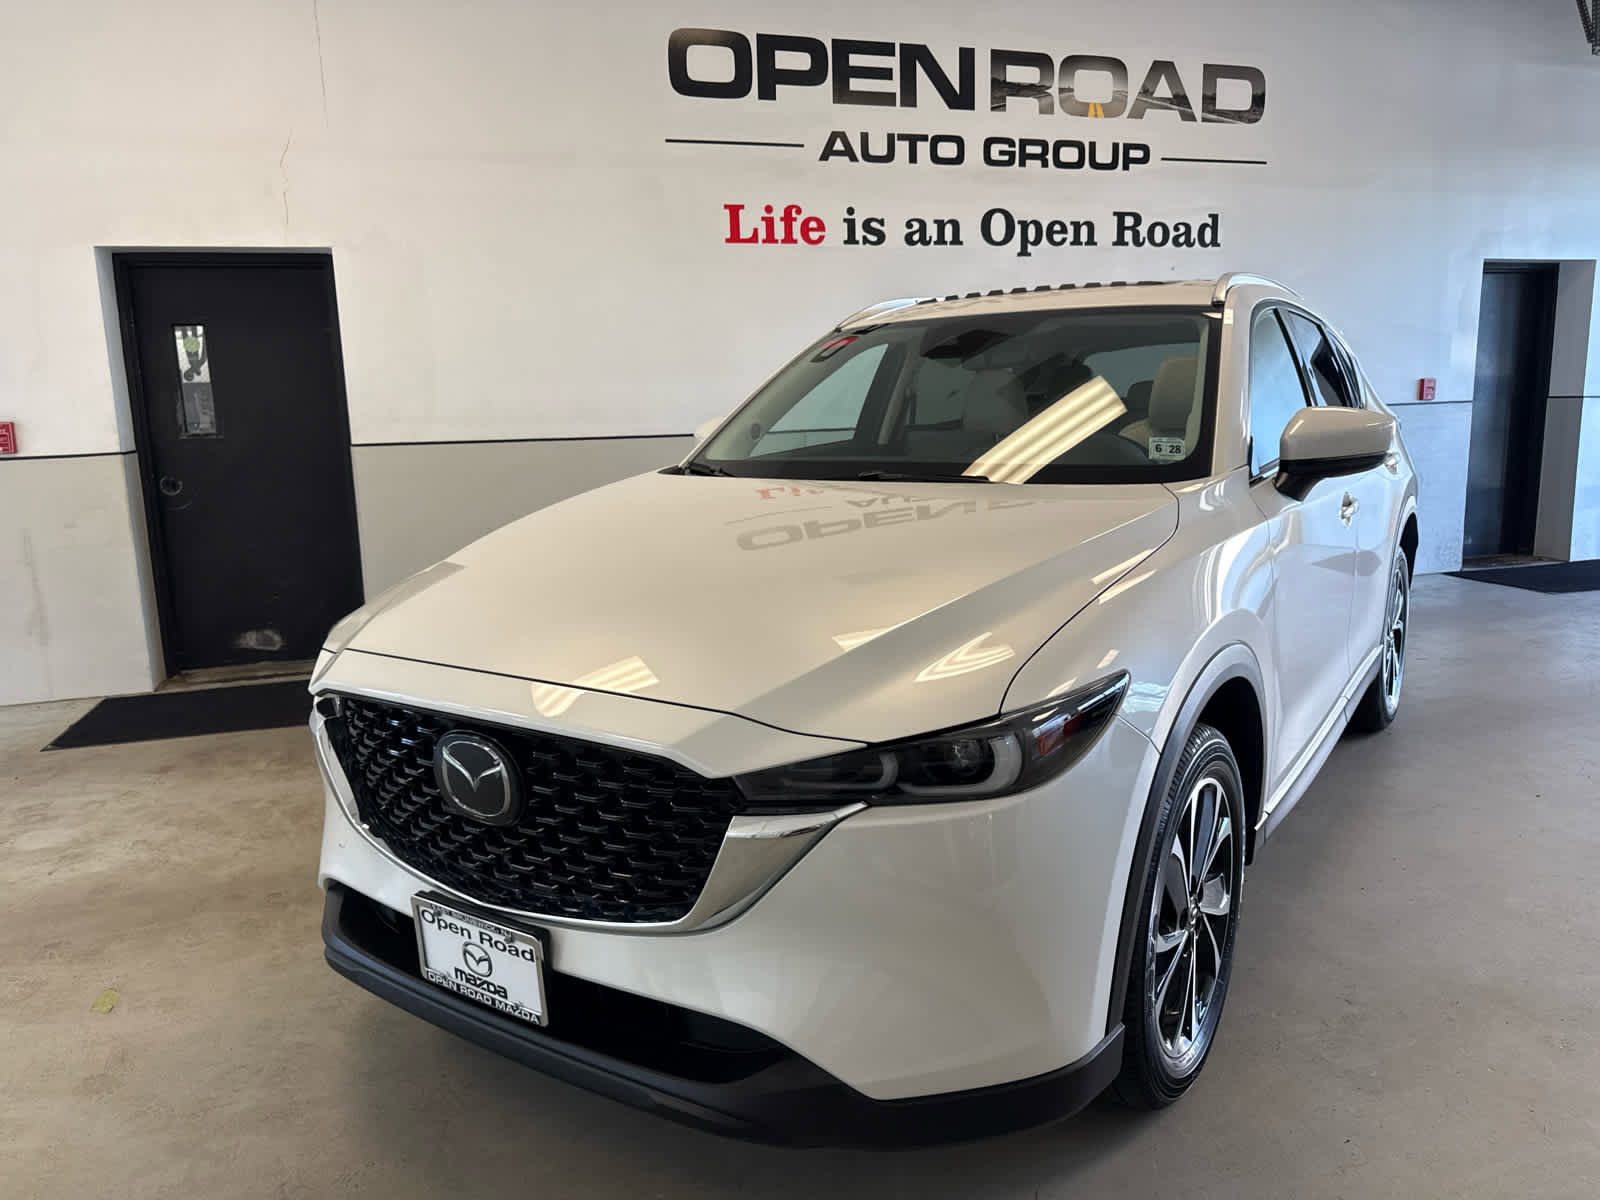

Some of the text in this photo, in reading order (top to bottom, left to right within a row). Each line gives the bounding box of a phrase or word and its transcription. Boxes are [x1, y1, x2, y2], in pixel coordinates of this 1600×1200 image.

[667, 27, 1267, 125] OPEN ROAD
[818, 130, 1151, 172] AUTO GROUP
[723, 203, 1222, 258] Life is an Open Road
[1155, 443, 1182, 454] 6 28
[421, 908, 472, 940] Open
[479, 931, 535, 963] Road
[428, 971, 540, 1025] OPEN ROAD MAZDA
